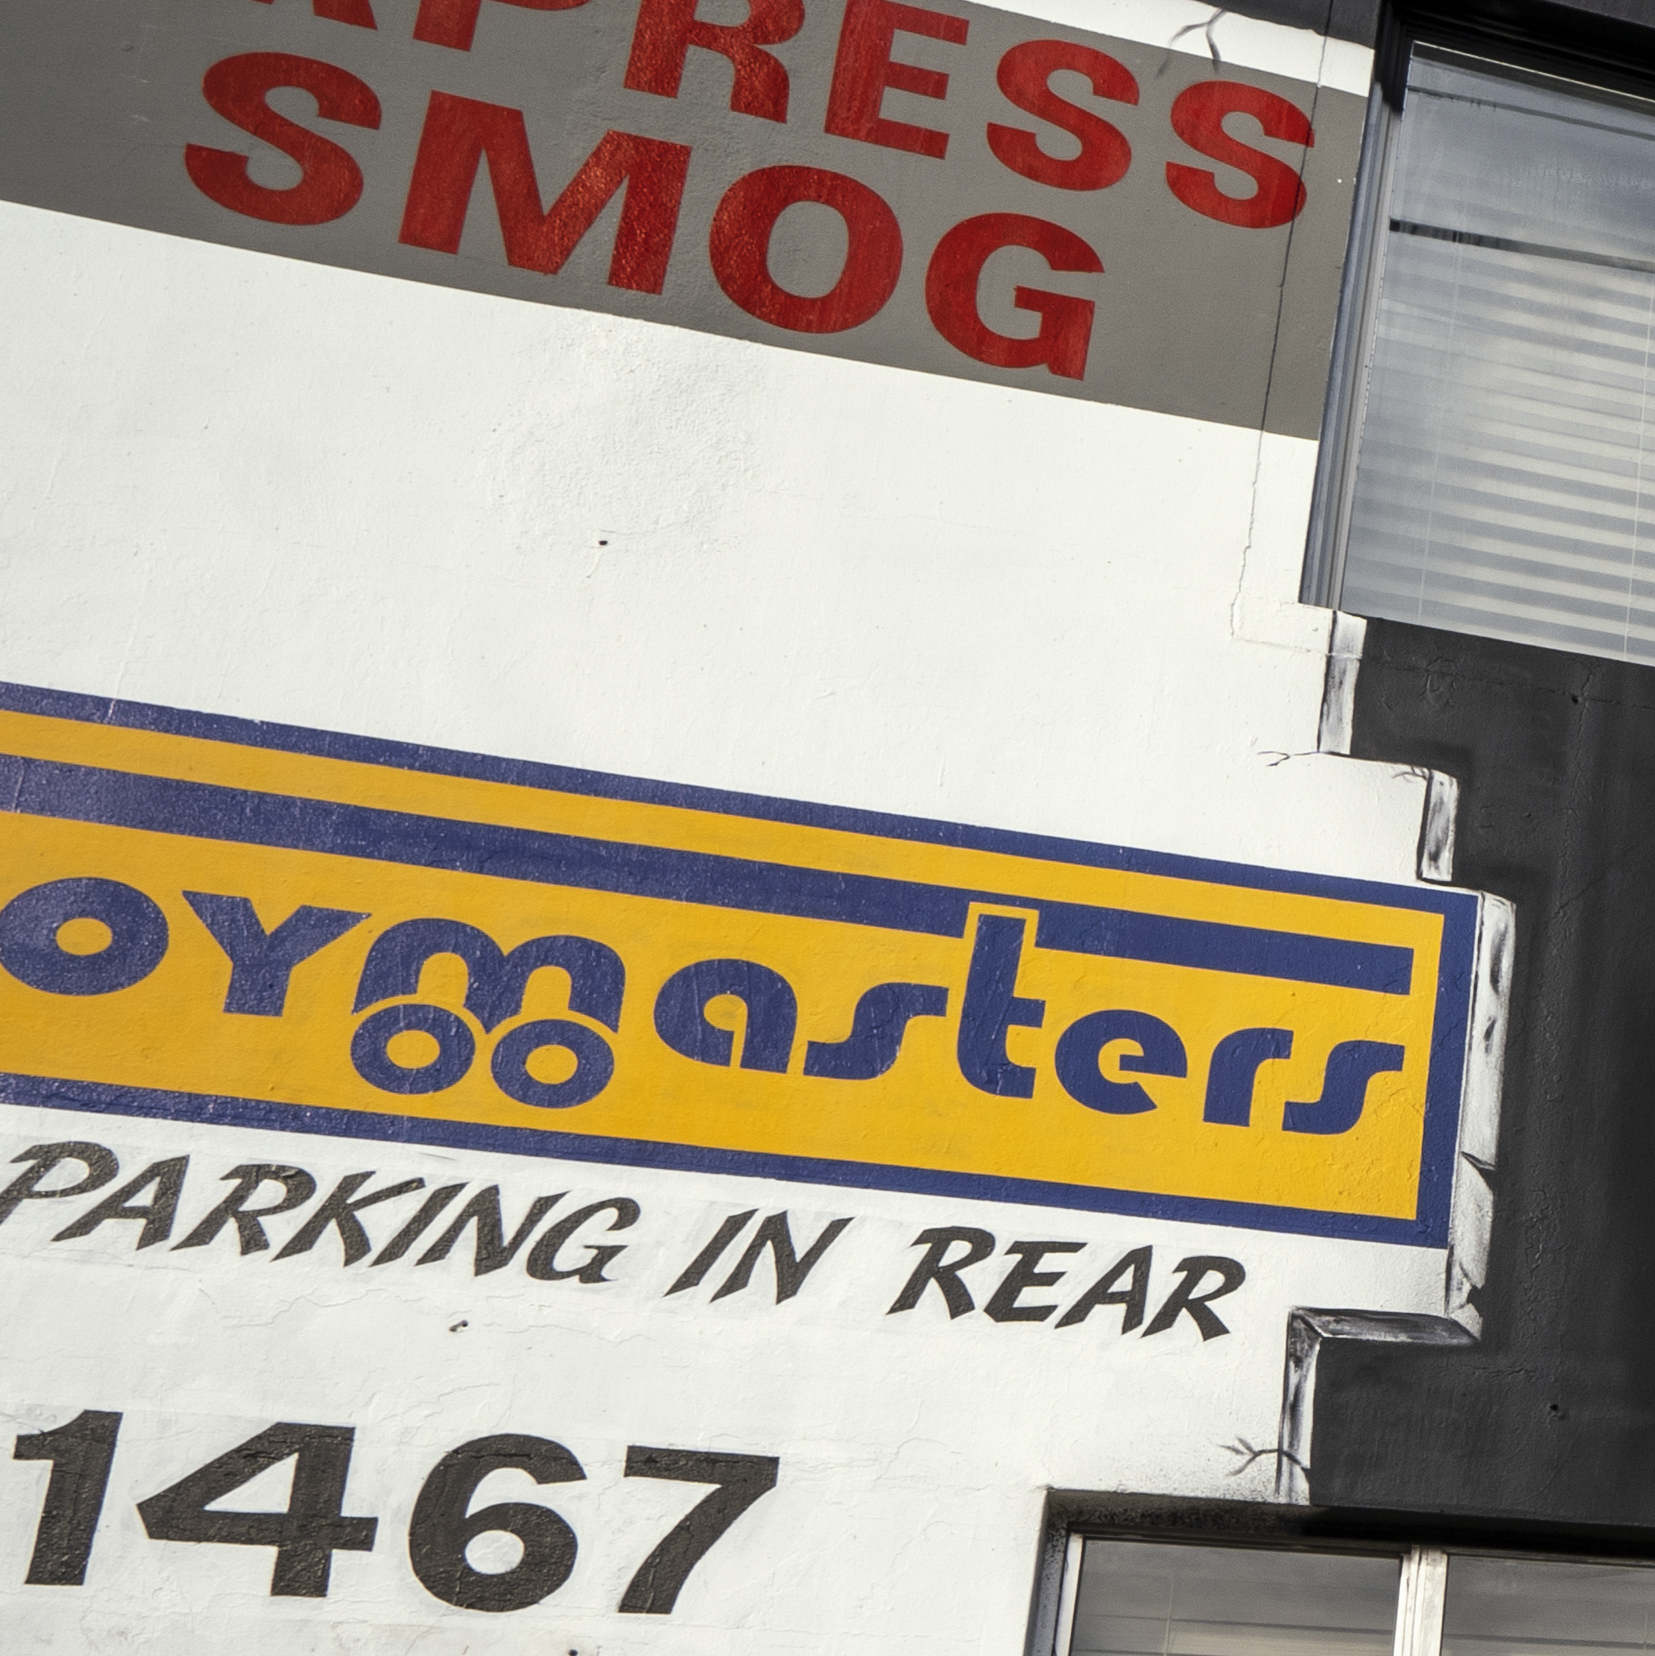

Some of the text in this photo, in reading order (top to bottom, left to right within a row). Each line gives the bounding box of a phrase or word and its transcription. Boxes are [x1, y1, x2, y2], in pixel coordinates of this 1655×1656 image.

[183, 50, 1106, 381] SMOG
[250, 0, 1316, 229] RESS
[0, 1140, 1246, 1341] PARKING IN REAR
[14, 1408, 780, 1615] 1467
